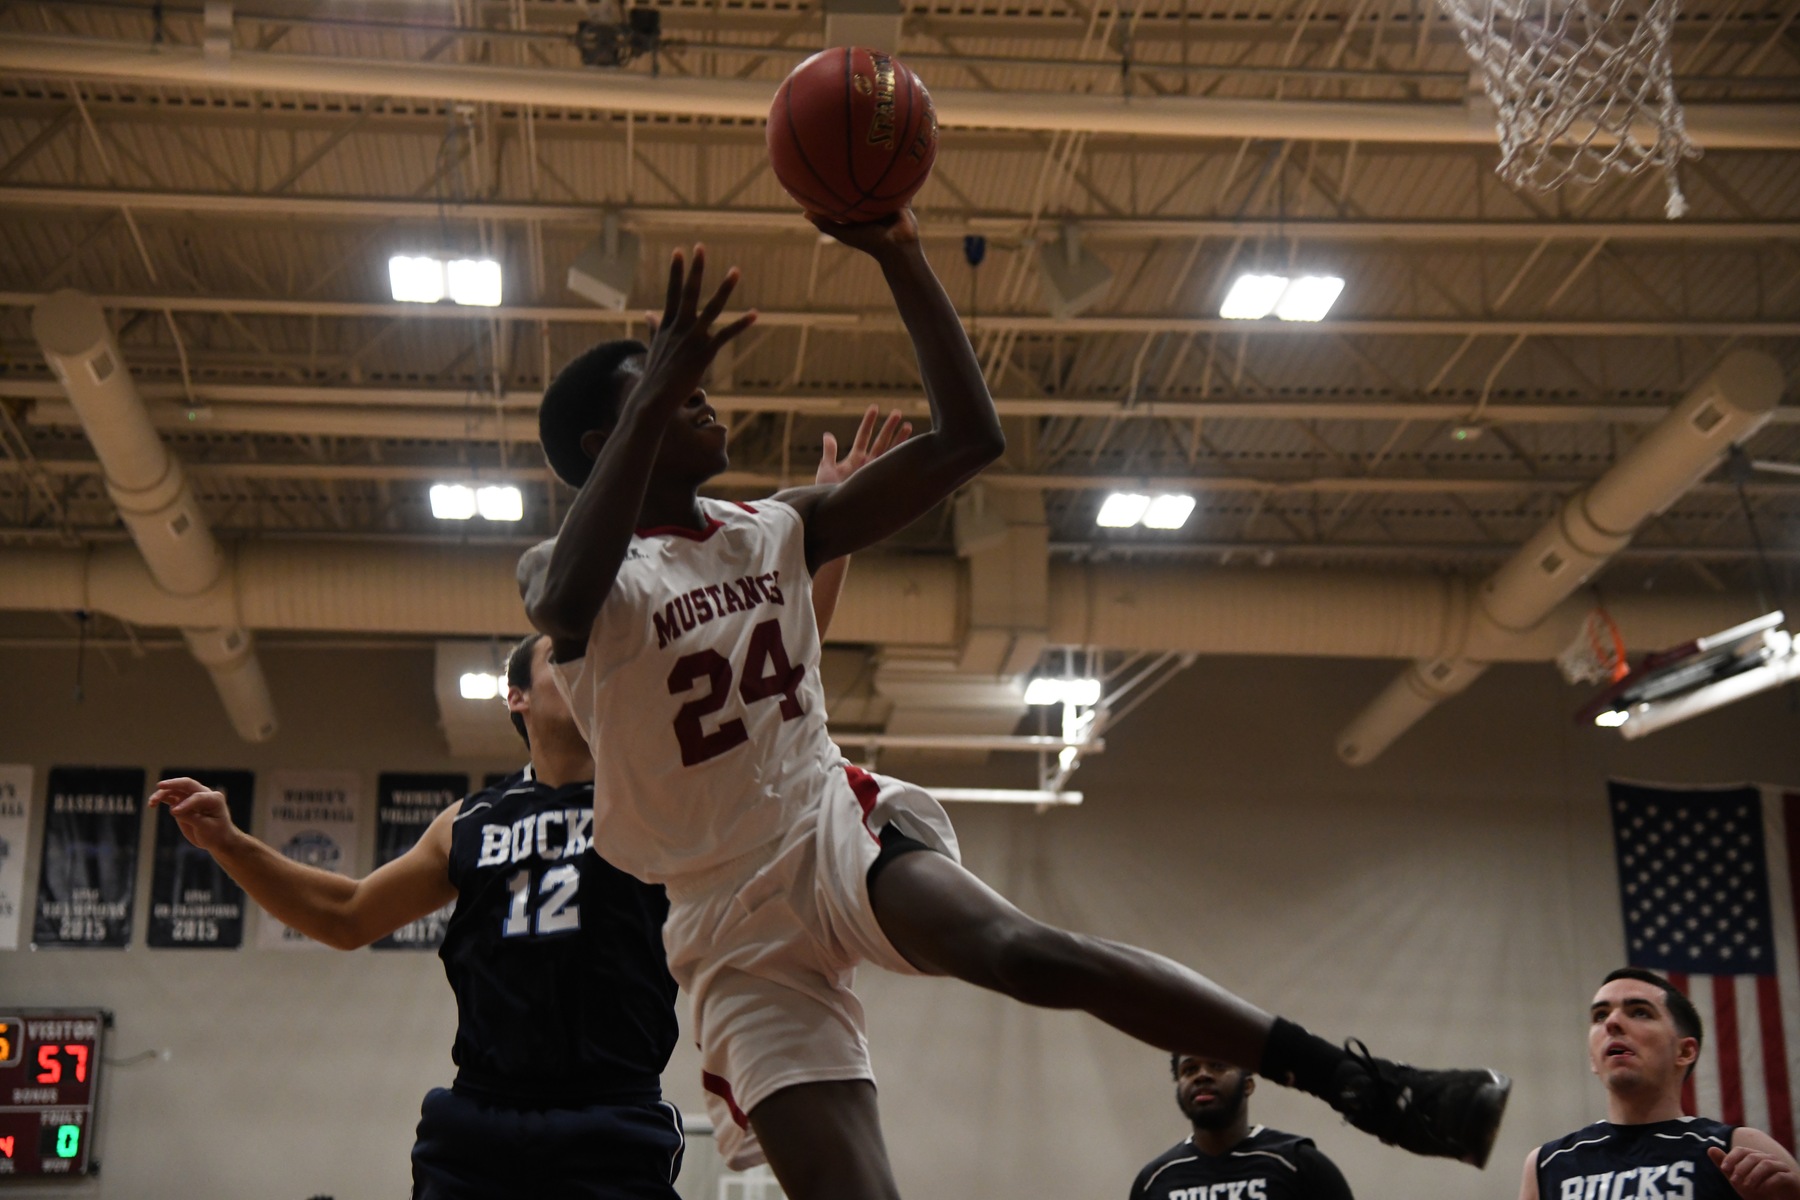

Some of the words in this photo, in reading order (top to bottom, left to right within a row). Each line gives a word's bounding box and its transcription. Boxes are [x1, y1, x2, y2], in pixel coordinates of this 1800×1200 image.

[667, 617, 806, 768] 24
[54, 793, 135, 814] BASEBALL
[380, 807, 438, 824] VOLLEY
[477, 808, 594, 868] BUCK
[502, 863, 581, 937] 12
[28, 1020, 96, 1041] VISITOR
[36, 1044, 88, 1084] 57
[56, 1124, 80, 1158] 0
[1560, 1159, 1695, 1200] BUCKS
